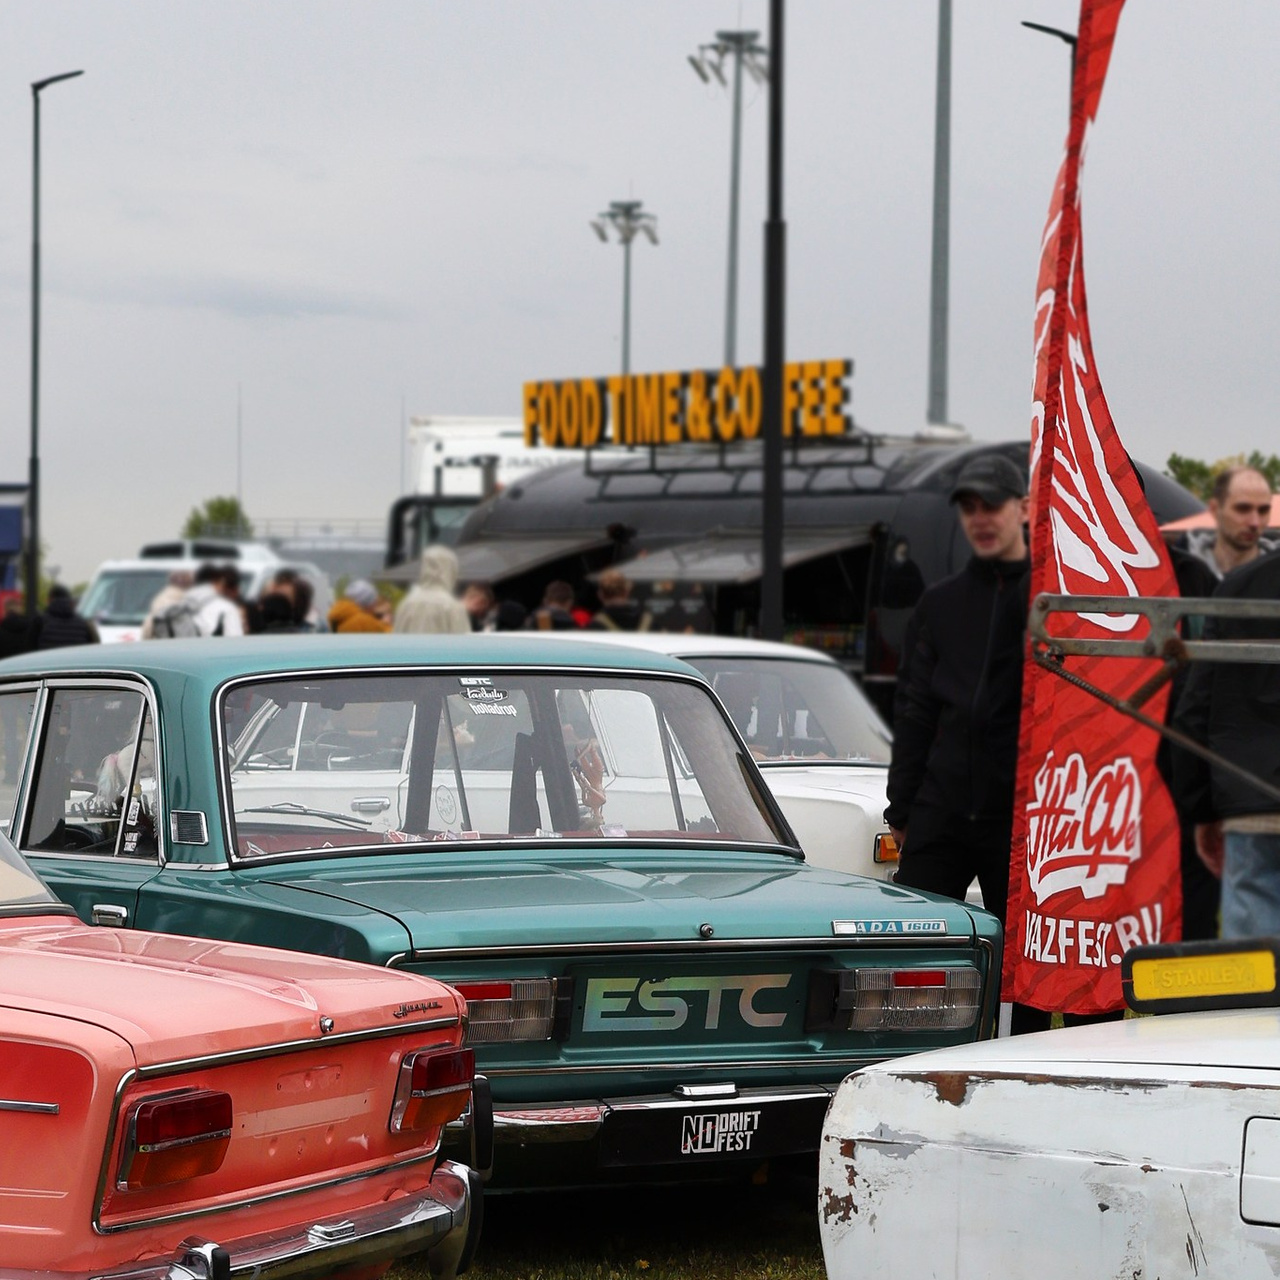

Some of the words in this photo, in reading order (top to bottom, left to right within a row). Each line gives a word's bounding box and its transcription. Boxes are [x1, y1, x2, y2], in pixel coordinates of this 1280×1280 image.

[523, 379, 601, 448] FOOD
[607, 372, 681, 445] TIME
[687, 370, 712, 441] &
[717, 358, 850, 442] COFEE
[907, 922, 941, 931] 1600
[1162, 967, 1246, 989] STANLEY
[582, 974, 794, 1033] ESTC
[719, 1111, 761, 1132] DRIFT
[718, 1131, 754, 1152] FEST
